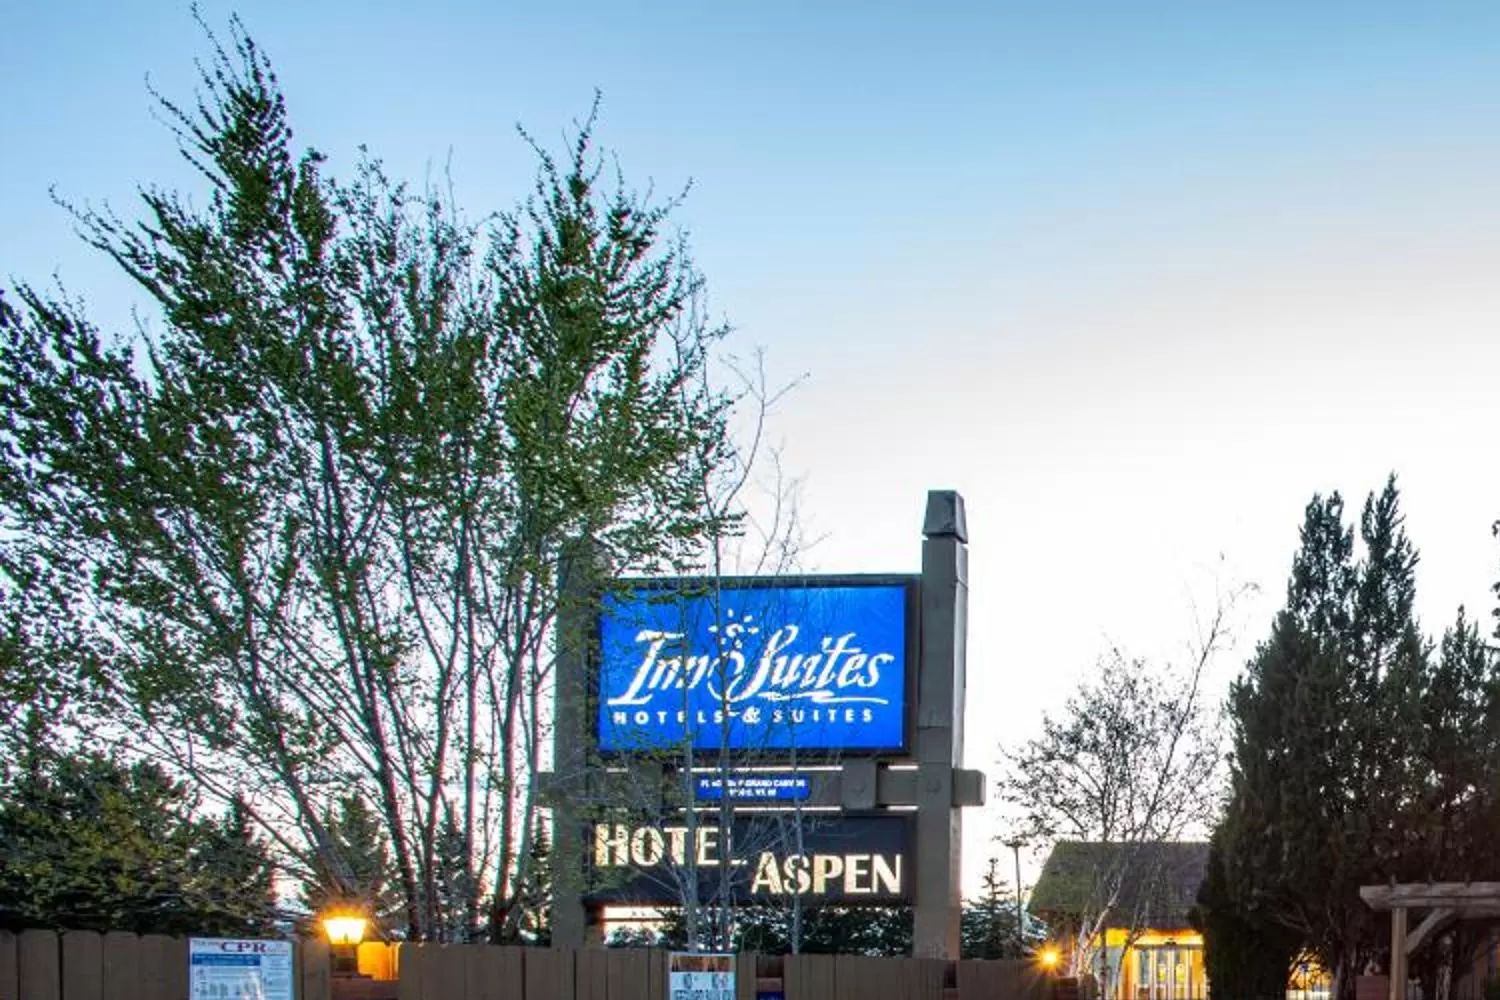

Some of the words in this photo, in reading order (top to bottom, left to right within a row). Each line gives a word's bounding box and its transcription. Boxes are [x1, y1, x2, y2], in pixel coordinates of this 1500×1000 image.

[613, 709, 724, 725] HOTELS
[742, 706, 761, 724] &
[772, 709, 873, 723] SUITES
[750, 851, 902, 895] ASPEN
[221, 941, 268, 953] CPR
